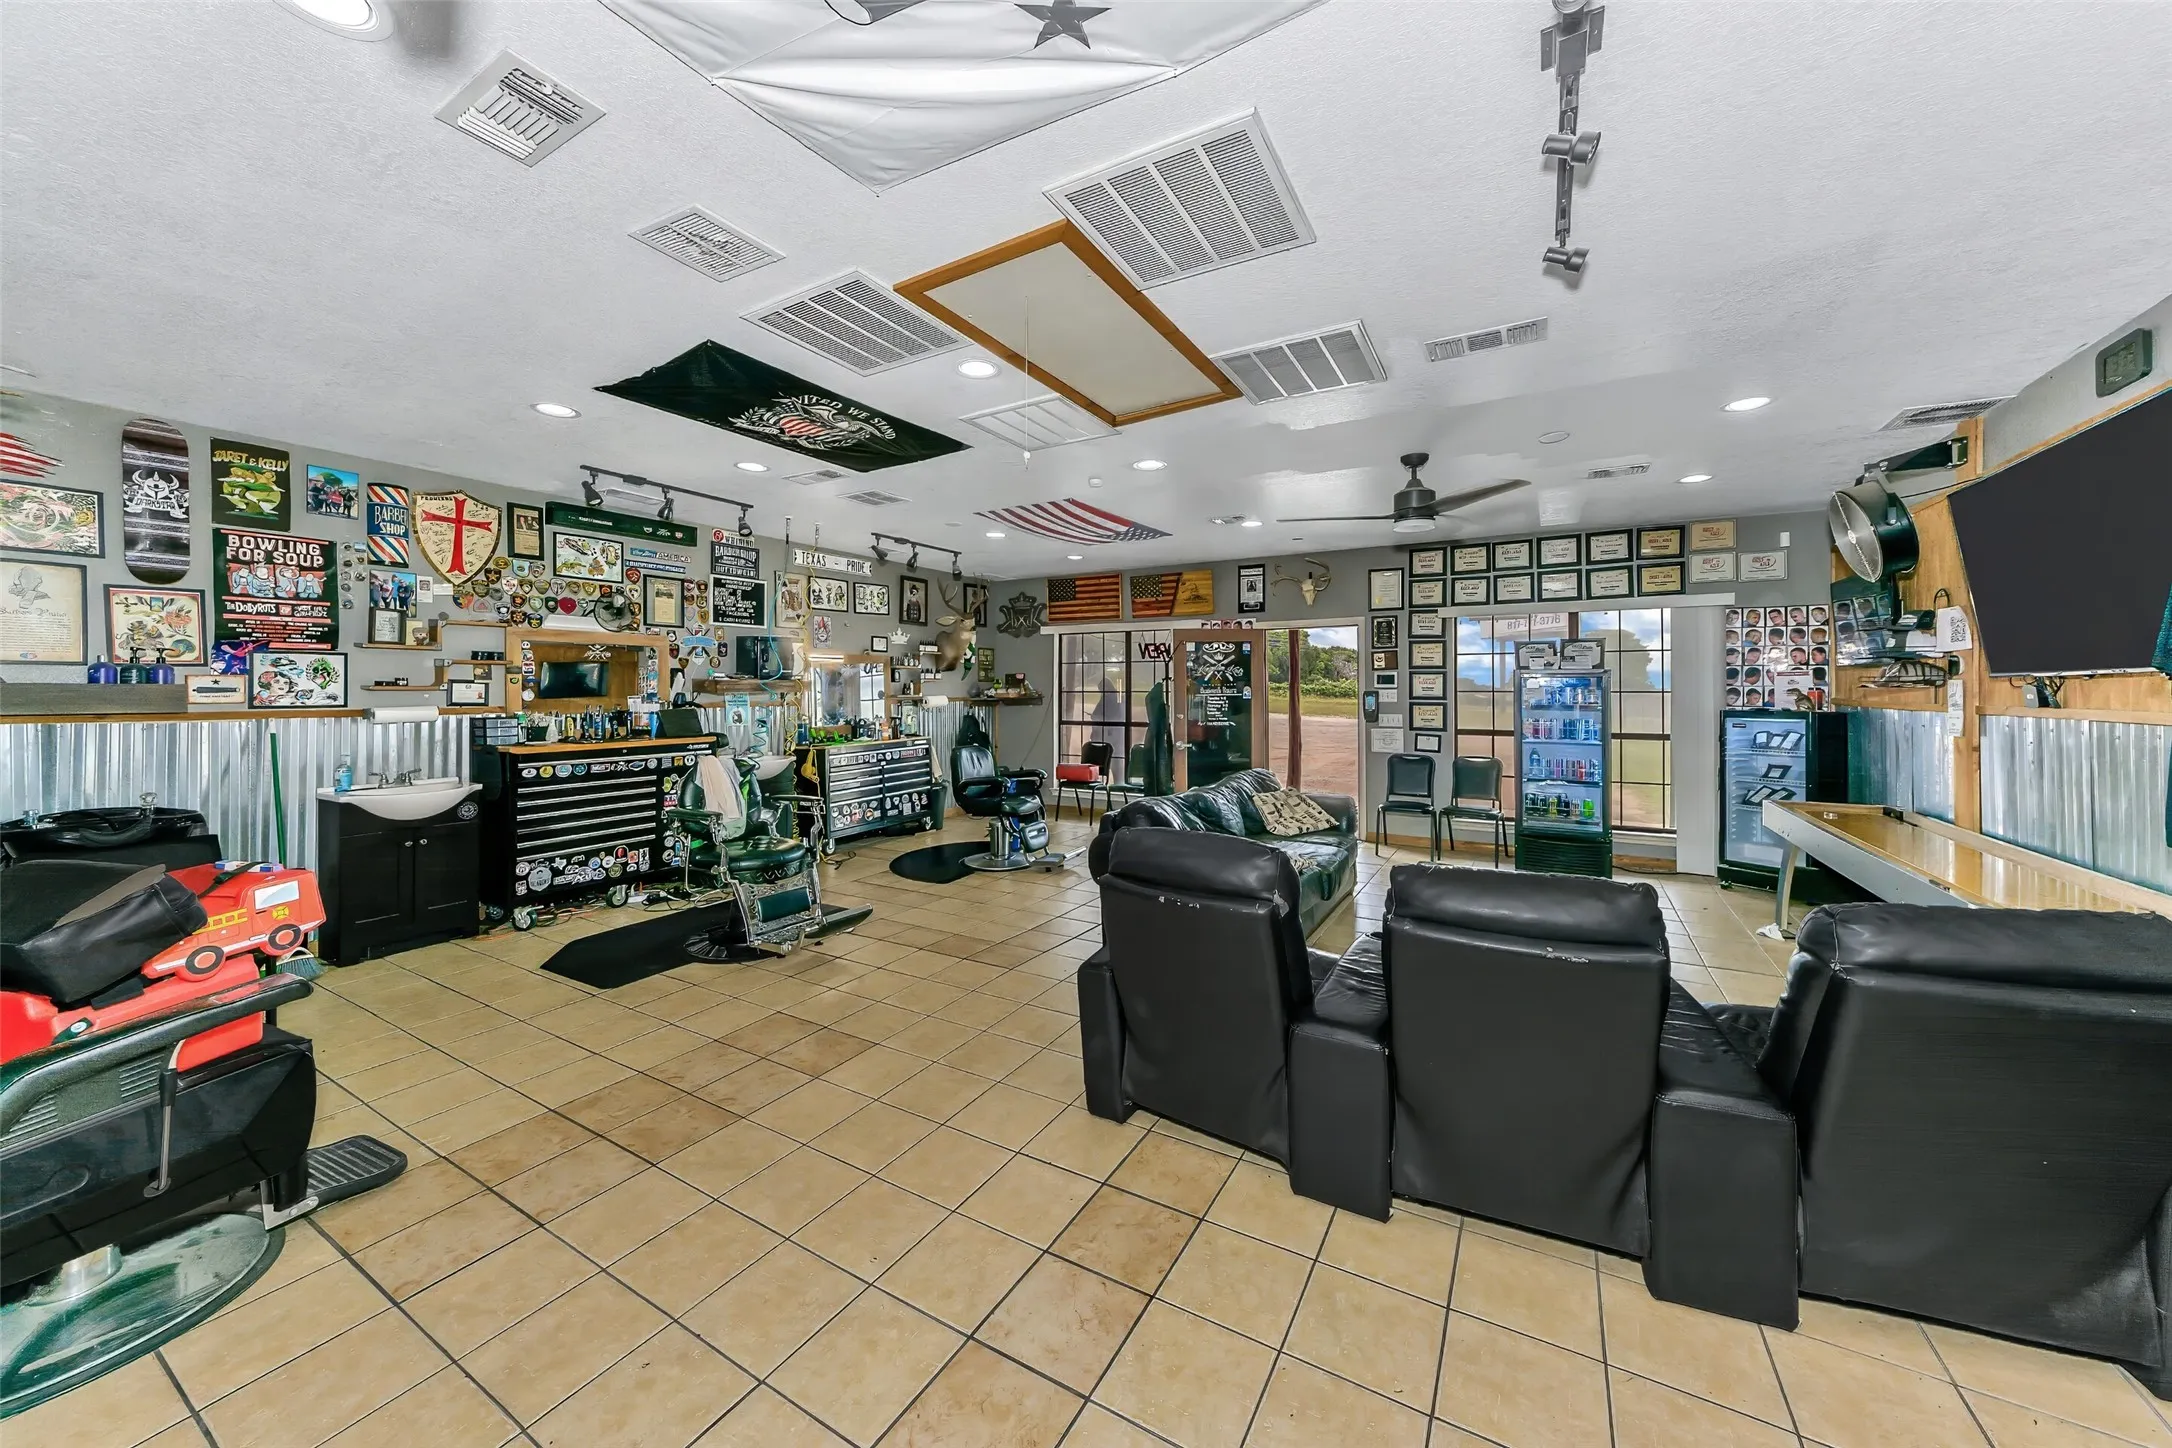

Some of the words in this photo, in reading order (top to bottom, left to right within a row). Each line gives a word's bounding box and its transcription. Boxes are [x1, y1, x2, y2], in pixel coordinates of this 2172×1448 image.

[791, 395, 842, 409] NITED
[848, 407, 870, 420] WE
[870, 418, 896, 440] STAND
[259, 457, 289, 471] KELLY
[380, 522, 406, 535] SHOP
[228, 534, 321, 556] BOWLING
[226, 546, 265, 562] FOR
[272, 551, 324, 568] SOUP
[801, 552, 826, 567] TEXAS
[846, 560, 866, 573] PRIDE
[1506, 614, 1561, 630] 817-77-3776
